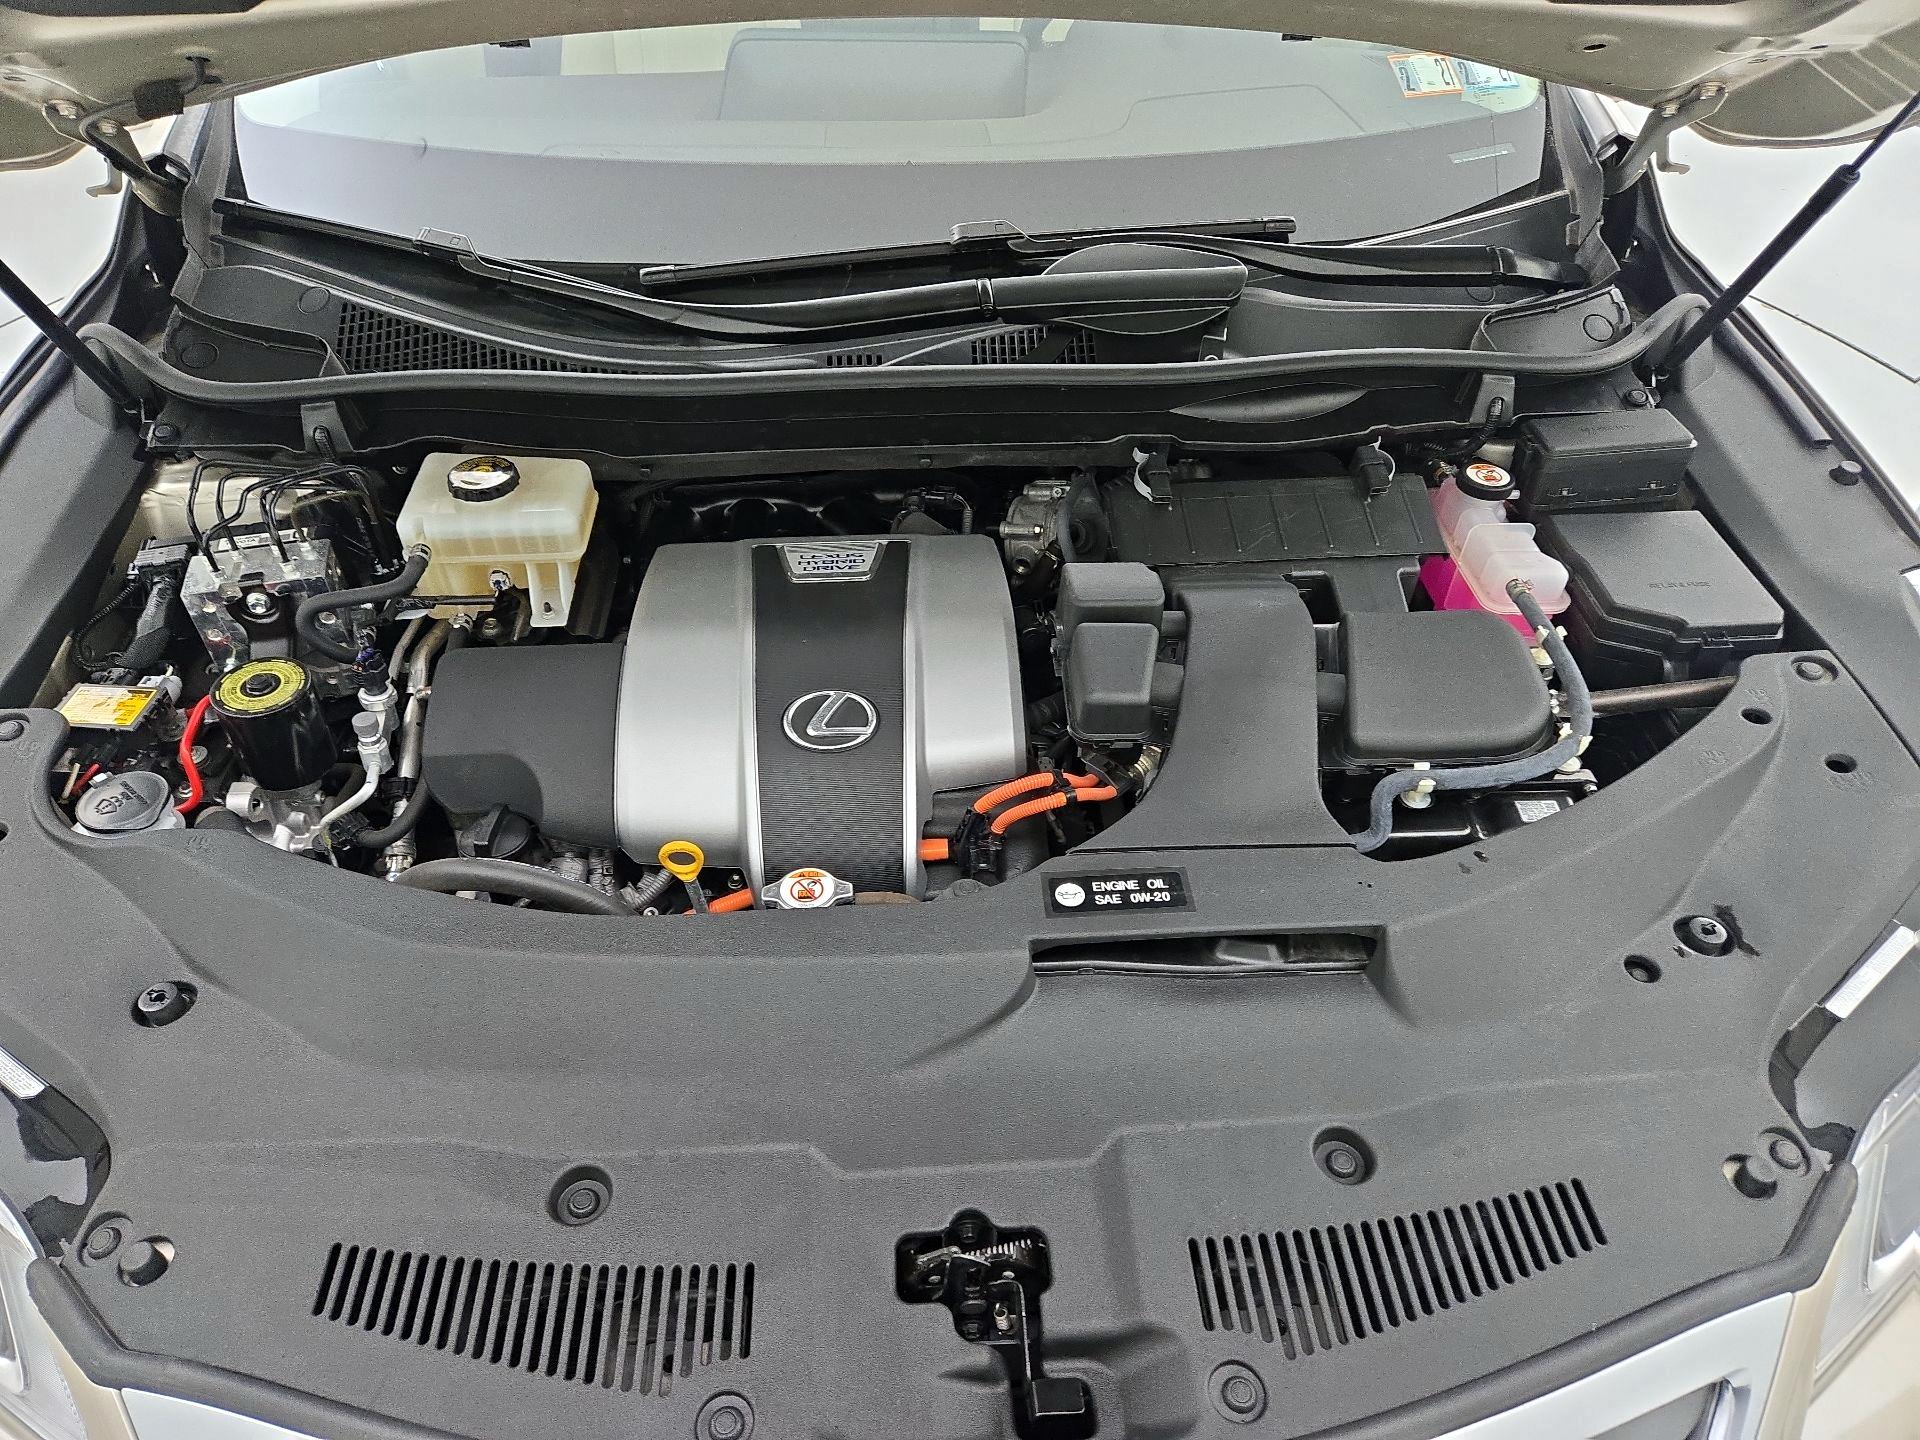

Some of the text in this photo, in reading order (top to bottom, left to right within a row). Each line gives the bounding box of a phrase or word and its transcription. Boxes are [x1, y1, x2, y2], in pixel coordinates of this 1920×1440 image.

[1092, 879, 1169, 892] ENGINE OIL
[1094, 891, 1171, 905] SAE 0W-20
